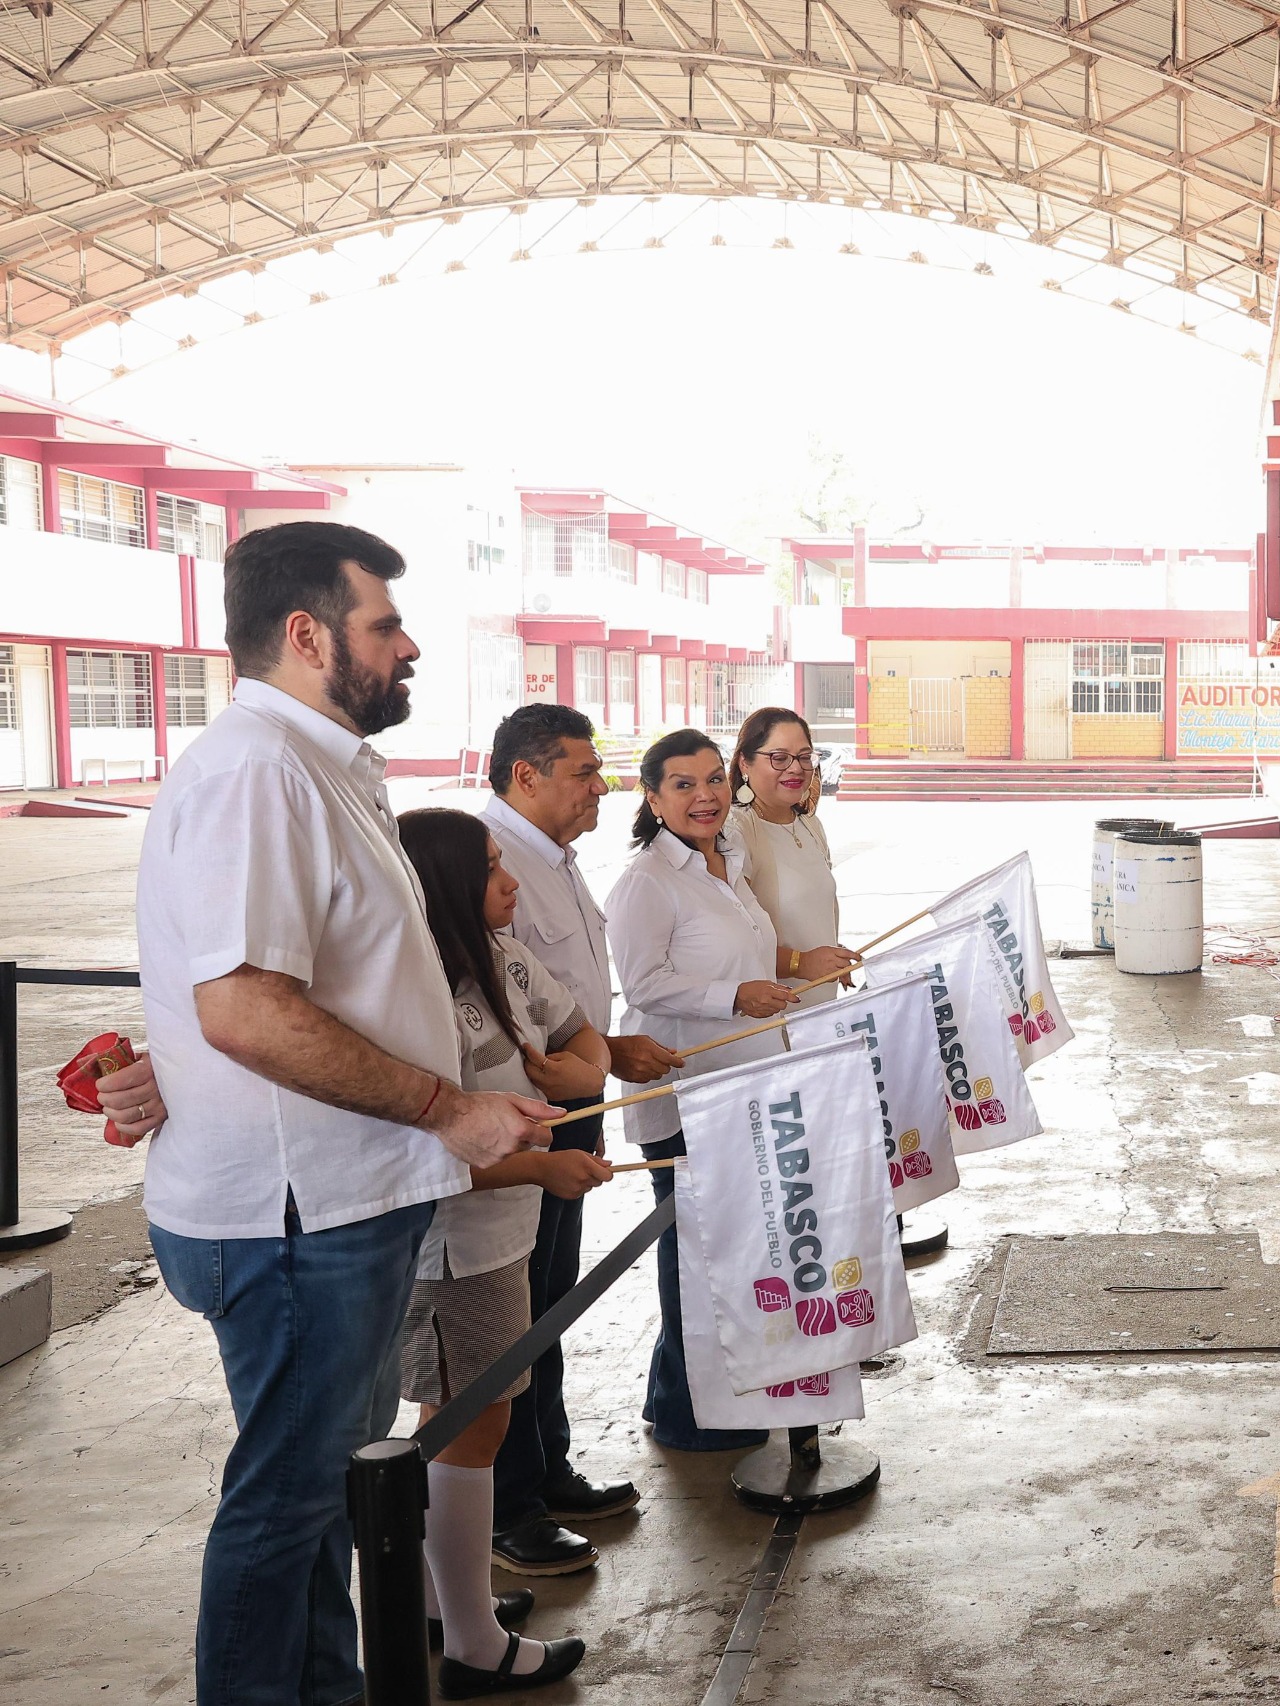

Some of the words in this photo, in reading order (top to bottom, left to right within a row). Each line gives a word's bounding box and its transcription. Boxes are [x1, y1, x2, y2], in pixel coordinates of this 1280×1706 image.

[542, 674, 555, 683] DE
[1180, 730, 1236, 750] Montejo
[983, 901, 1029, 1019] TABASCO
[1001, 975, 1019, 1009] PUEBLO
[927, 962, 972, 1101] TABASCO
[748, 1100, 770, 1176] GOBIERNO
[759, 1179, 773, 1208] DEL
[768, 1091, 827, 1293] TABASCO
[764, 1211, 783, 1269] PUEBLO
